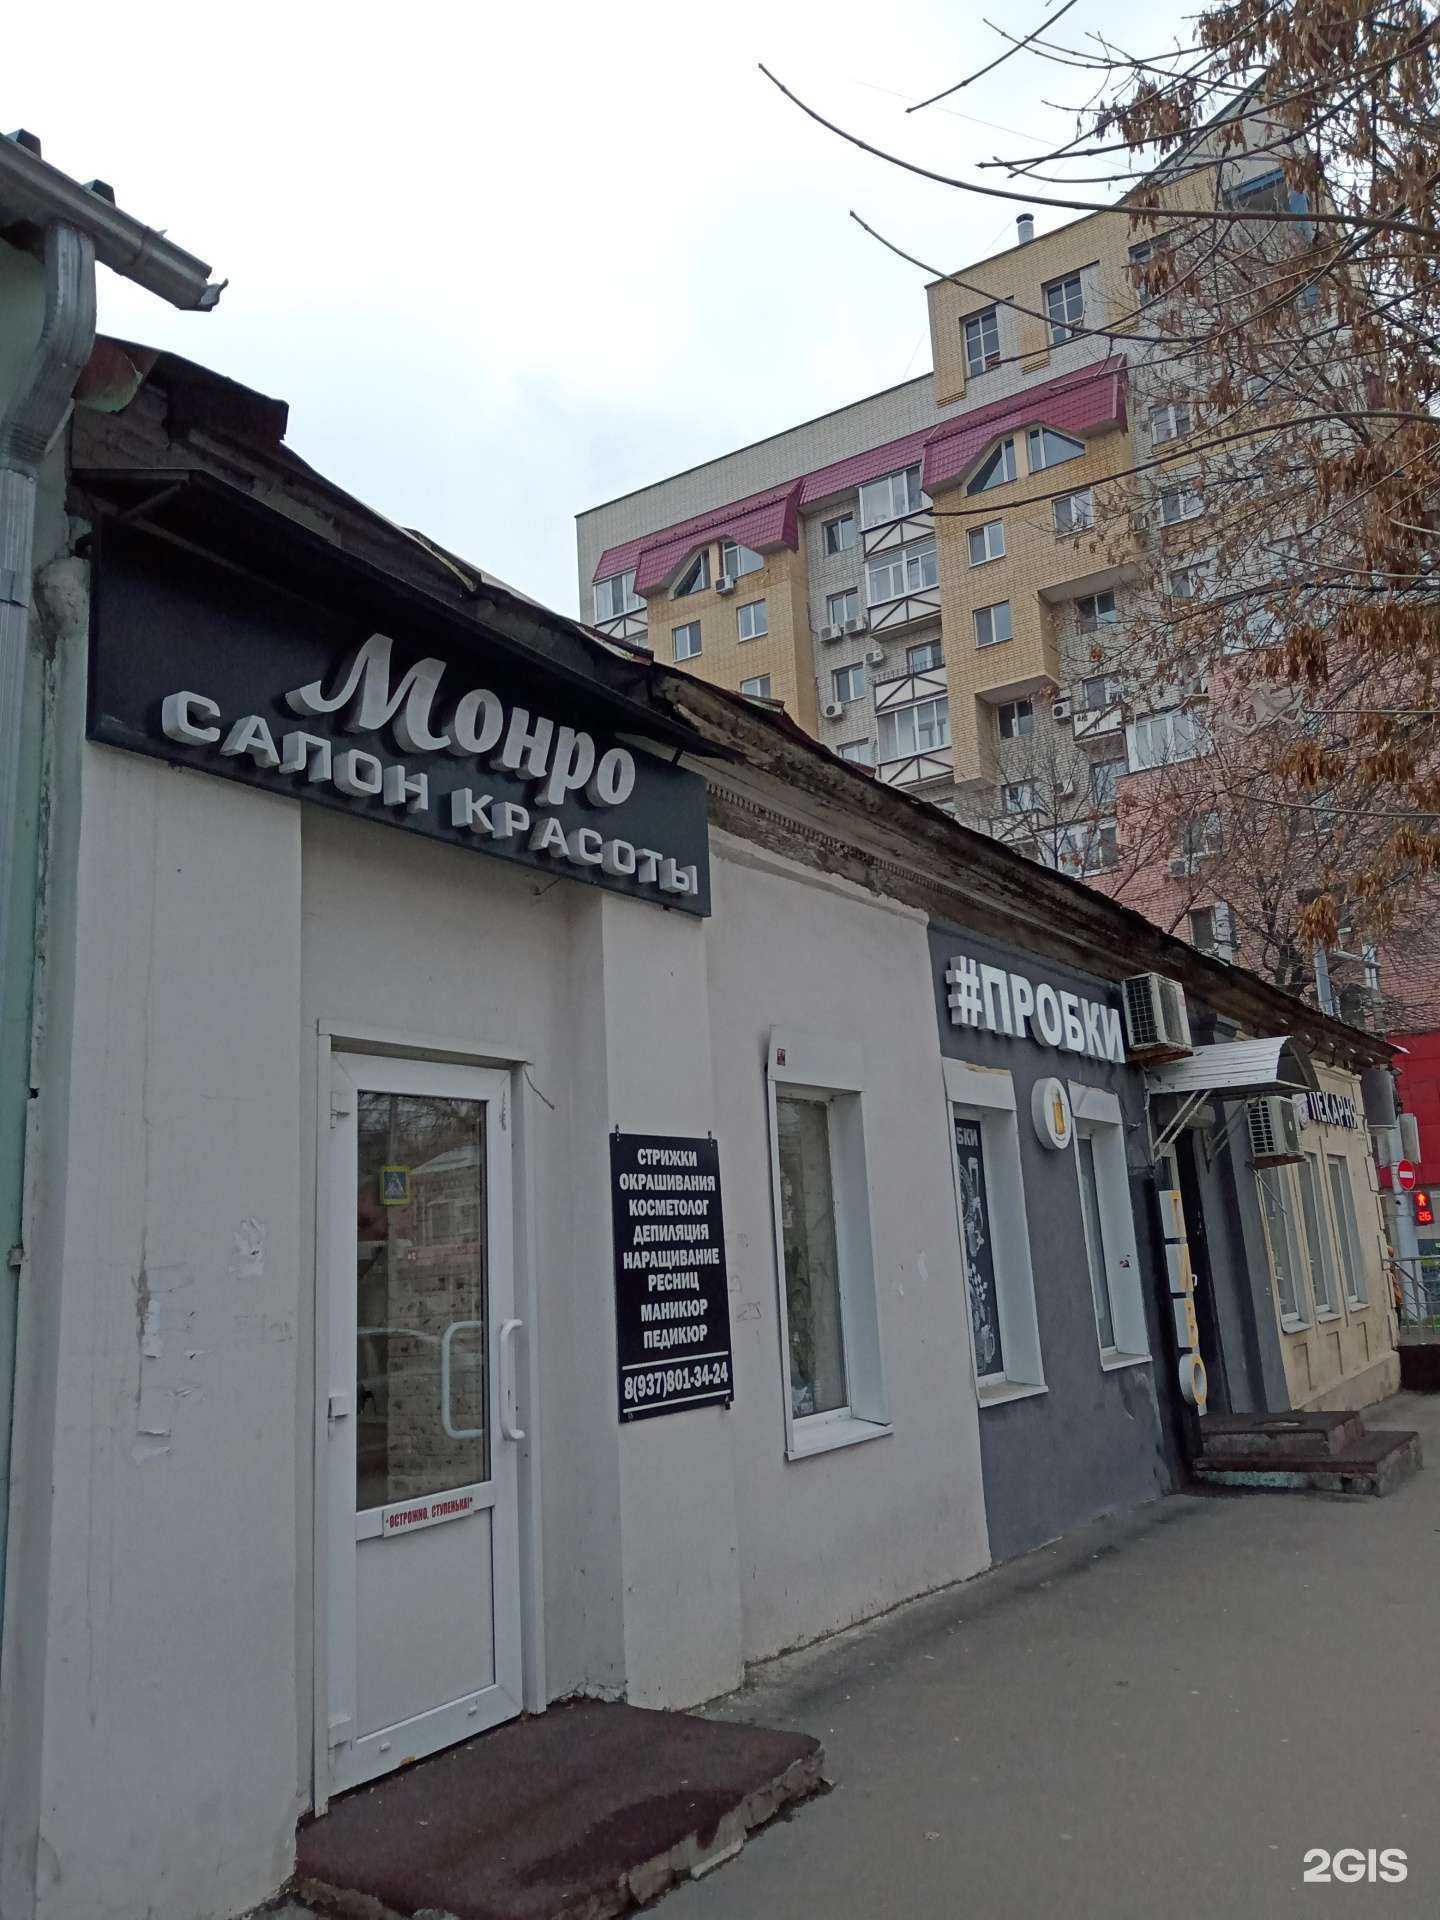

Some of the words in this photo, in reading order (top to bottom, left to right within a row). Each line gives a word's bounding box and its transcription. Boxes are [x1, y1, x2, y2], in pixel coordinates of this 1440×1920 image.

[285, 633, 636, 806] Монро
[162, 691, 429, 813] САЛОН
[451, 787, 699, 896] КРАСОТЫ
[946, 955, 1126, 1064] #ПРОБКИ
[637, 1148, 698, 1167] СТРИЖКИ
[619, 1173, 716, 1192] ОКРАШИВАНИЯ
[629, 1199, 709, 1217] КОСМЕТОЛОГ
[633, 1223, 709, 1245] ДЕПИЛЯЦИЯ
[623, 1248, 720, 1270] НАРАЩИВАНИЕ
[648, 1271, 700, 1293] РЕСНИЦ
[640, 1298, 708, 1322] МАНИКЮР
[643, 1324, 708, 1350] ПЕДИКЮР
[624, 1361, 729, 1402] 8(937)801-34-24
